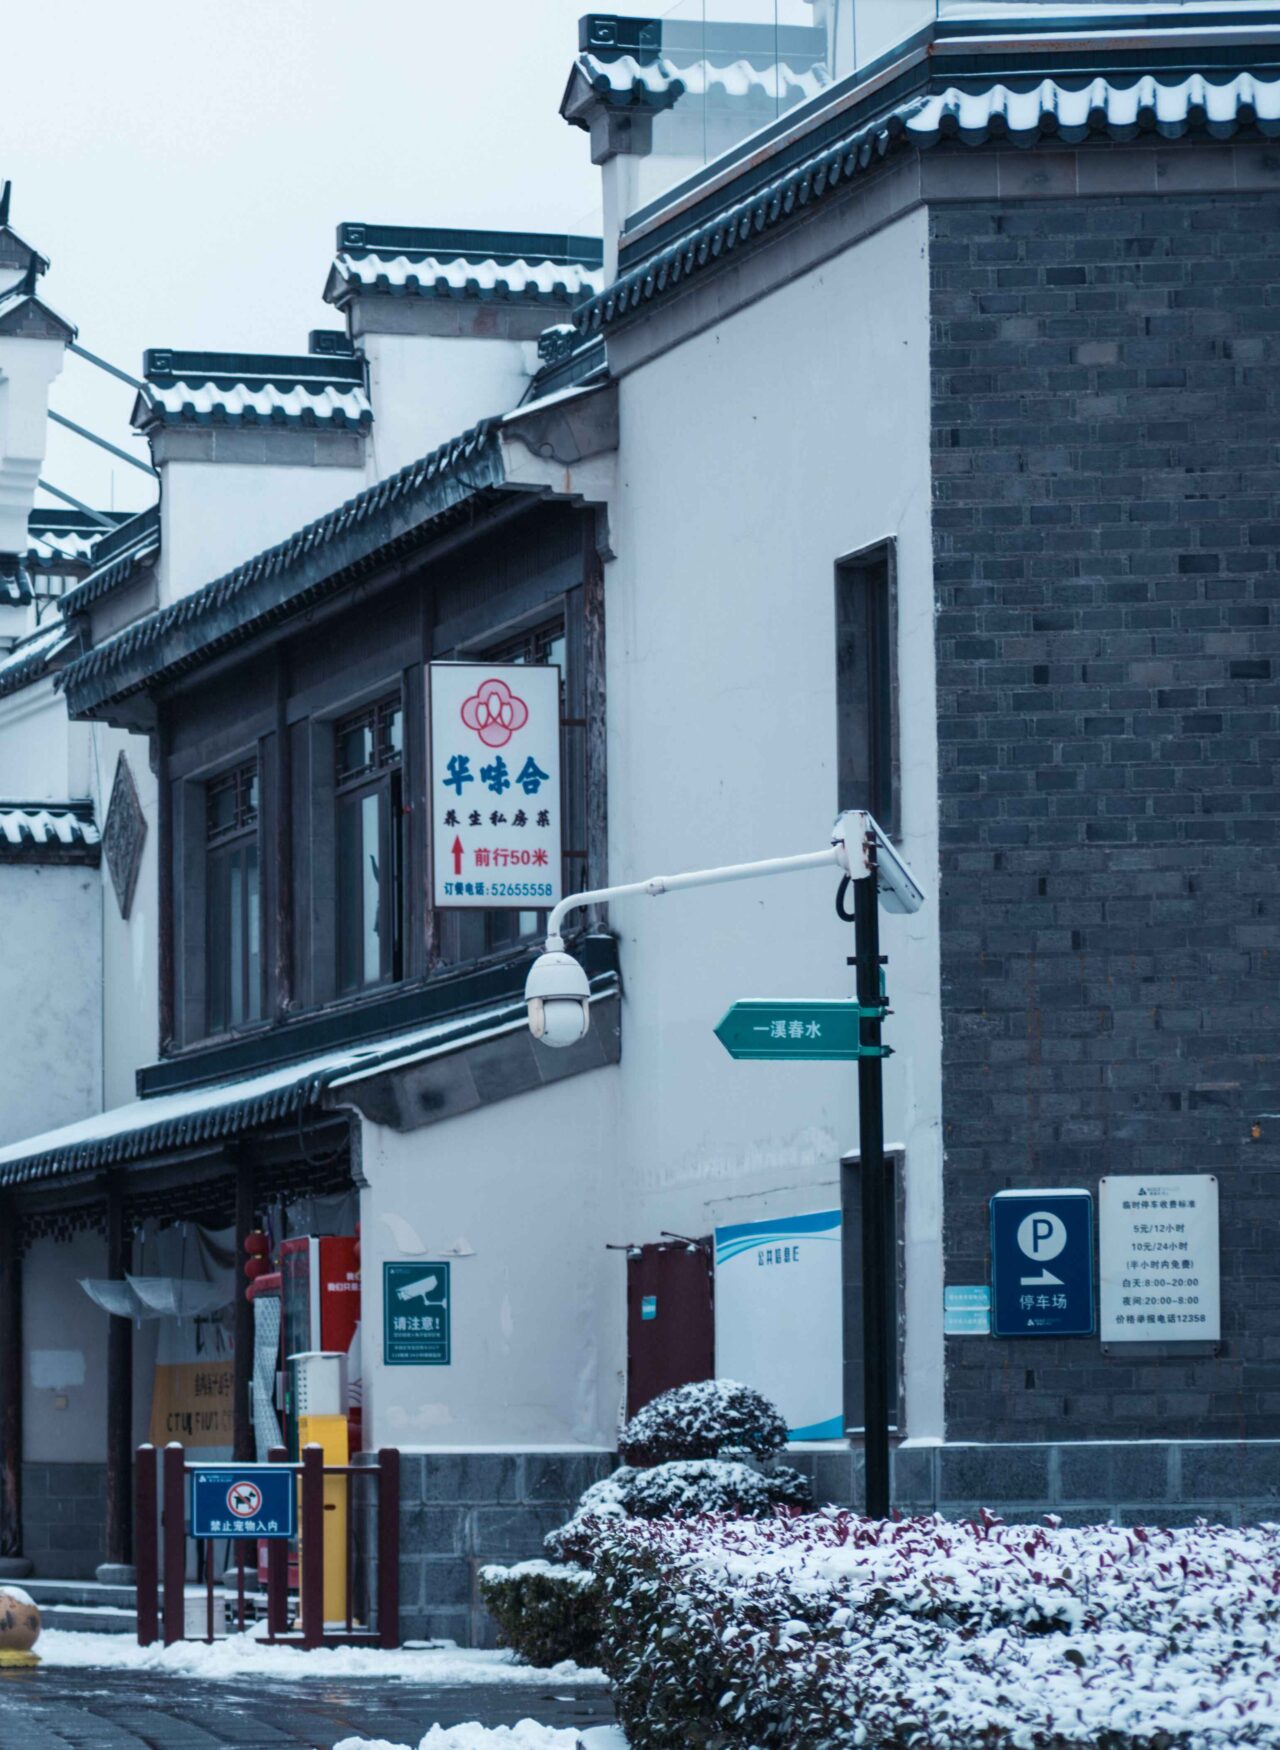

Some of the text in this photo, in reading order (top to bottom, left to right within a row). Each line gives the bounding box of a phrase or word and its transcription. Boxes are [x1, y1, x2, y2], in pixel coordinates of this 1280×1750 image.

[442, 754, 550, 796] 华味合
[443, 808, 551, 828] 养生私房菜
[474, 847, 549, 867] 前行50米
[753, 1020, 821, 1038] 一溪春水
[1032, 1218, 1054, 1253] P
[1133, 1224, 1185, 1233] 5元/12小时
[1131, 1242, 1188, 1251] 10元/24小时
[1020, 1294, 1067, 1310] 停车场
[210, 1520, 278, 1532] 禁止宠物入内
